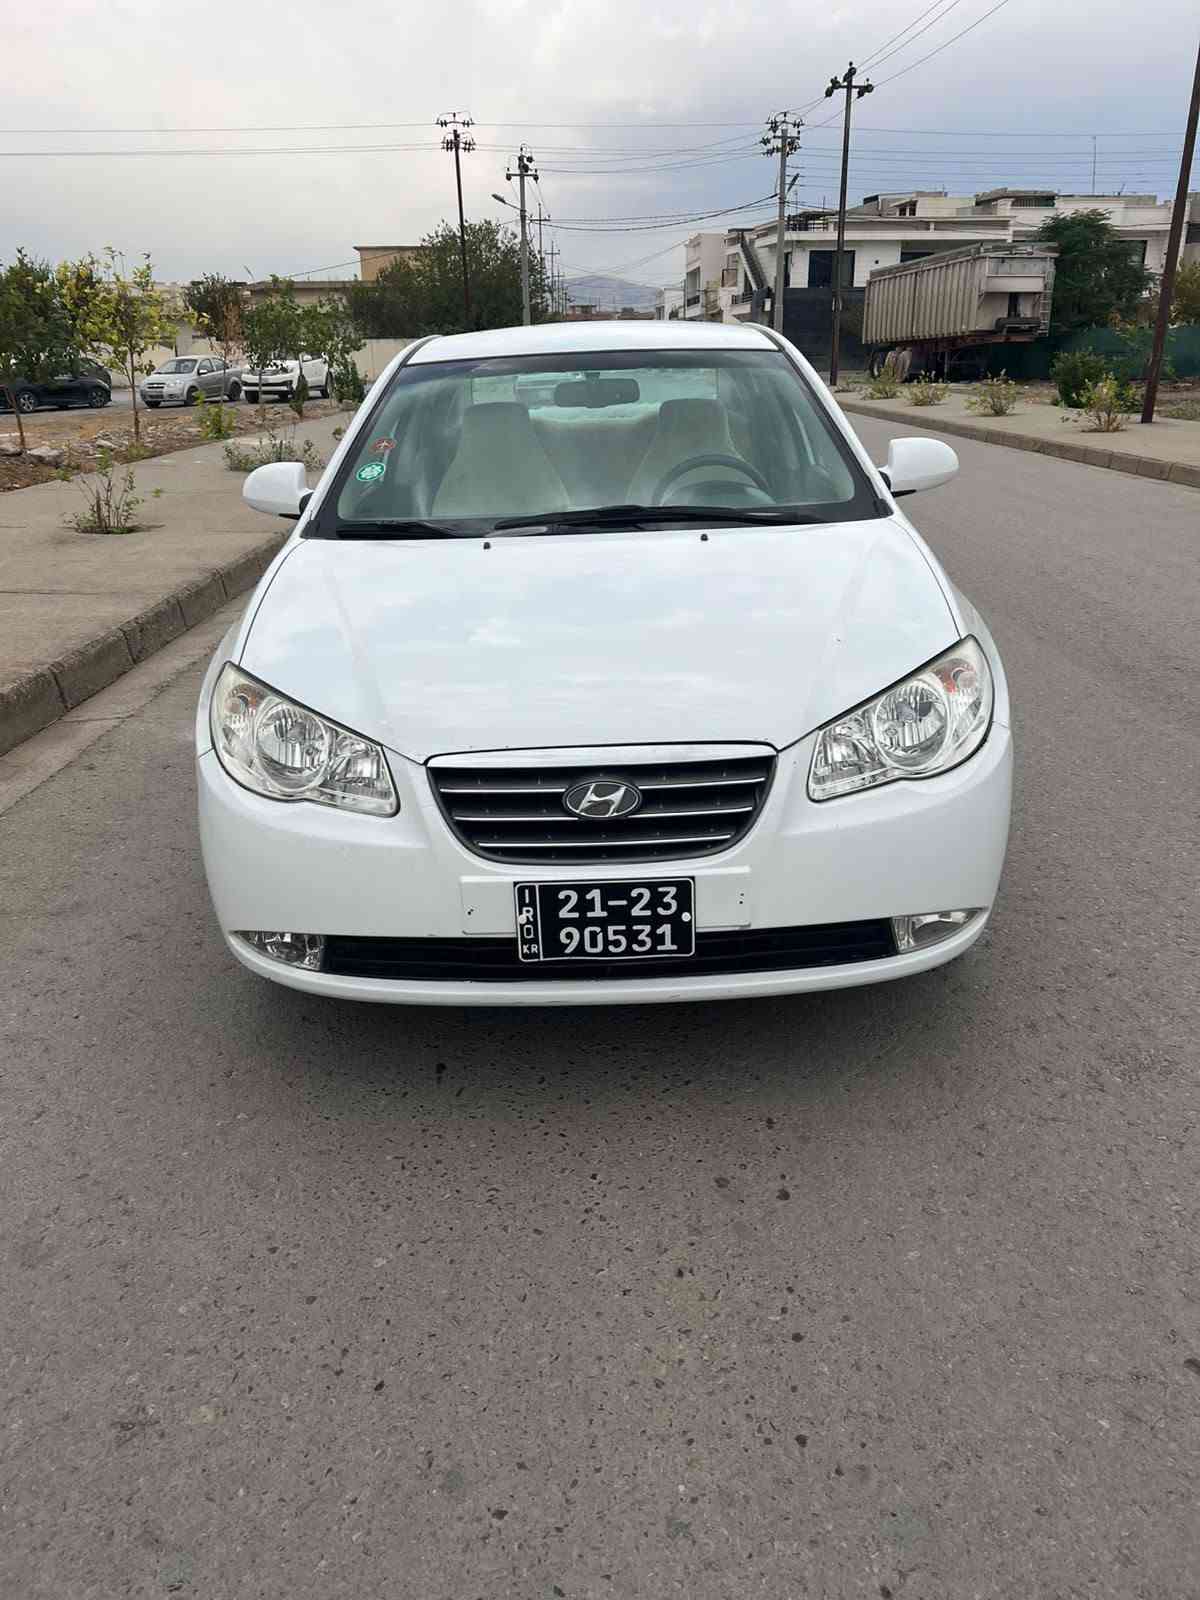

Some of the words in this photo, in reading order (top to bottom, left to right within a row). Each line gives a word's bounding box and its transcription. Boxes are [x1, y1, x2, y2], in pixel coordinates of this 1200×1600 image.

[557, 886, 678, 918] 21-23
[522, 944, 538, 954] KR
[559, 923, 678, 954] 90531
